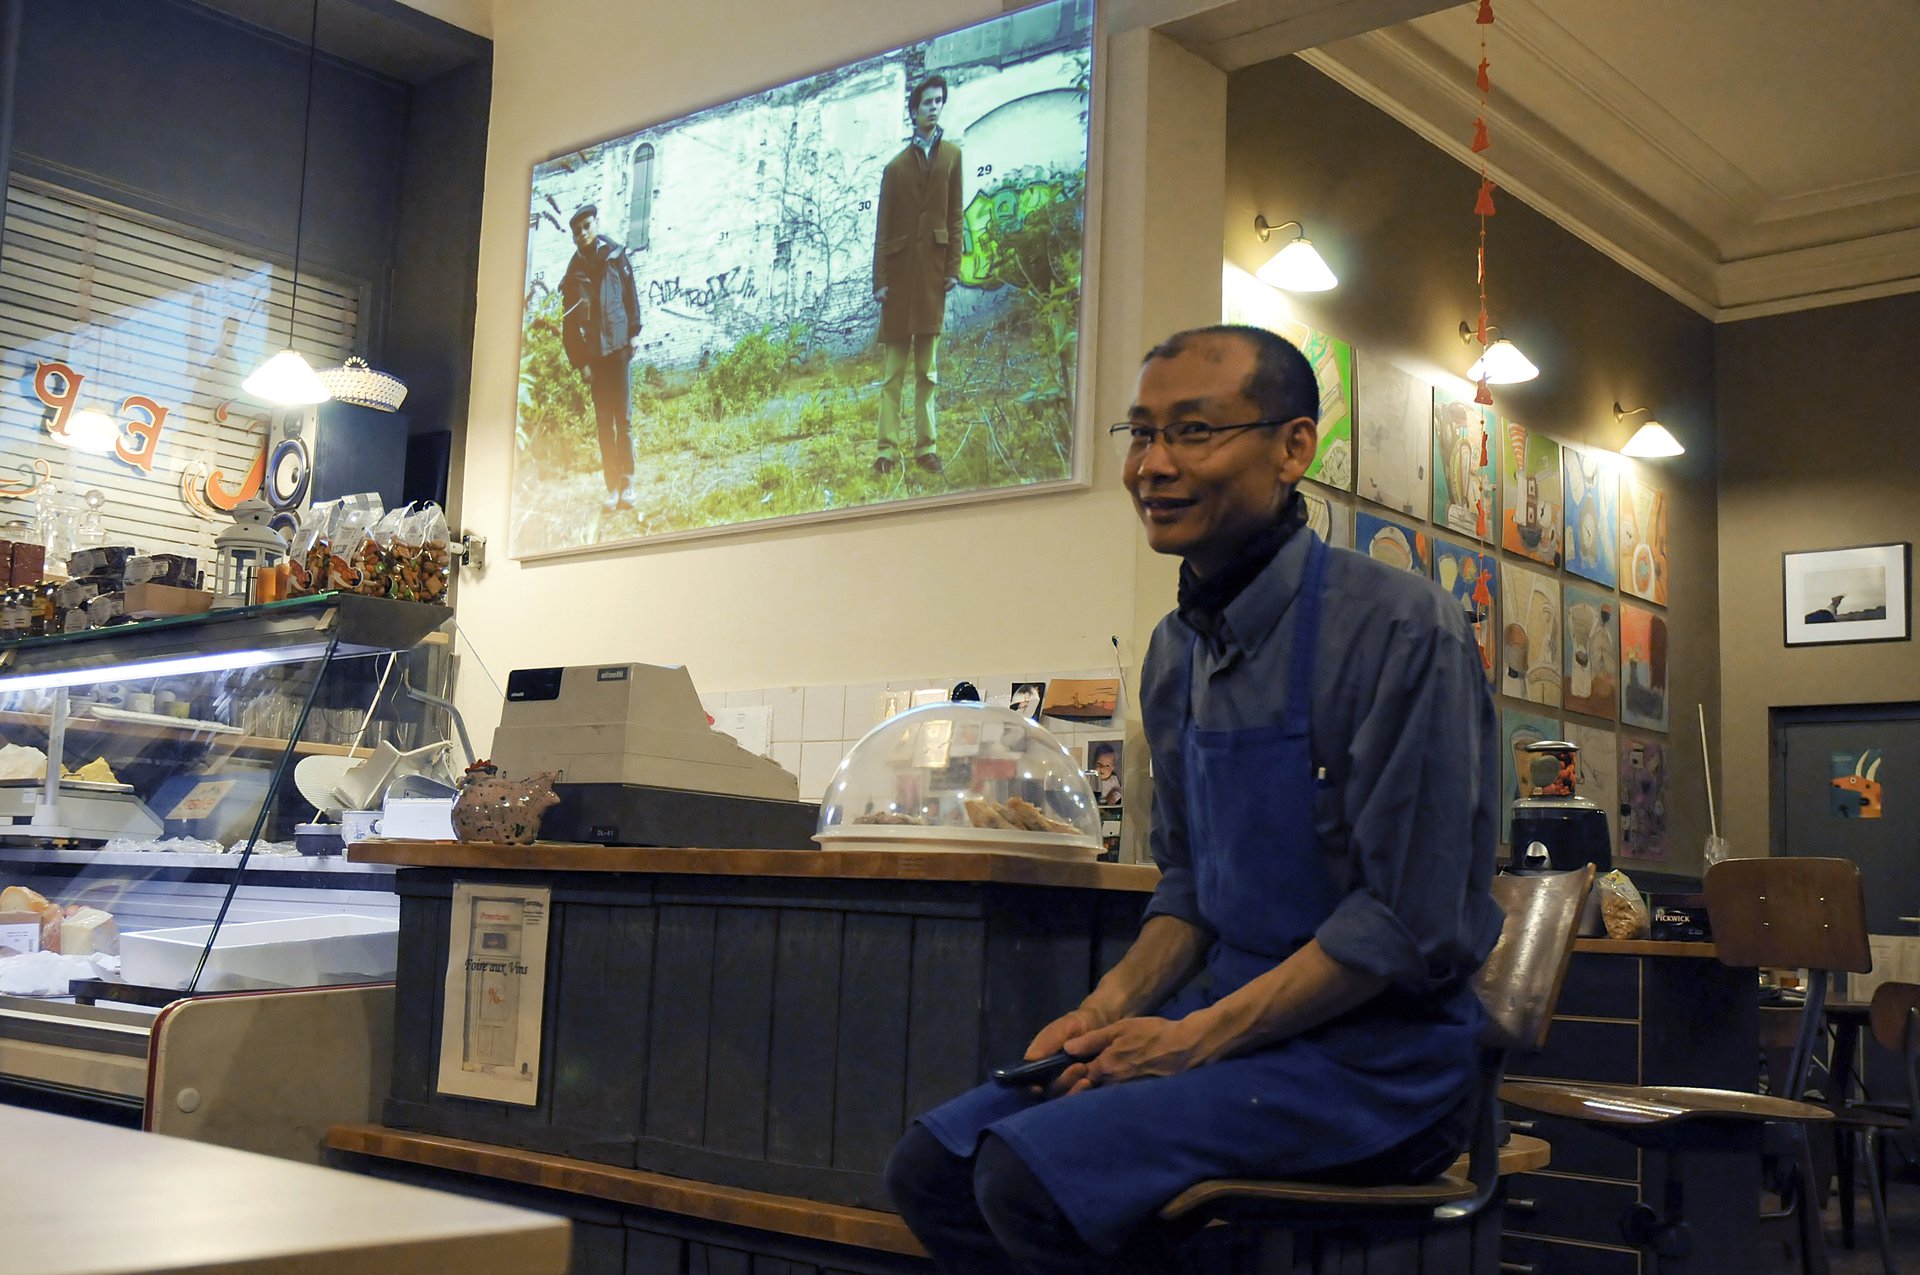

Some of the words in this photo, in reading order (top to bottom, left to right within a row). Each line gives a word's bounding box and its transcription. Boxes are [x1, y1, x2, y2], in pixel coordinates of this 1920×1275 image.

[976, 163, 993, 178] 29
[857, 199, 872, 212] 30
[718, 231, 730, 241] 31
[533, 271, 545, 281] 33
[465, 958, 488, 972] Foire
[489, 963, 508, 976] aux
[508, 961, 529, 975] Vins
